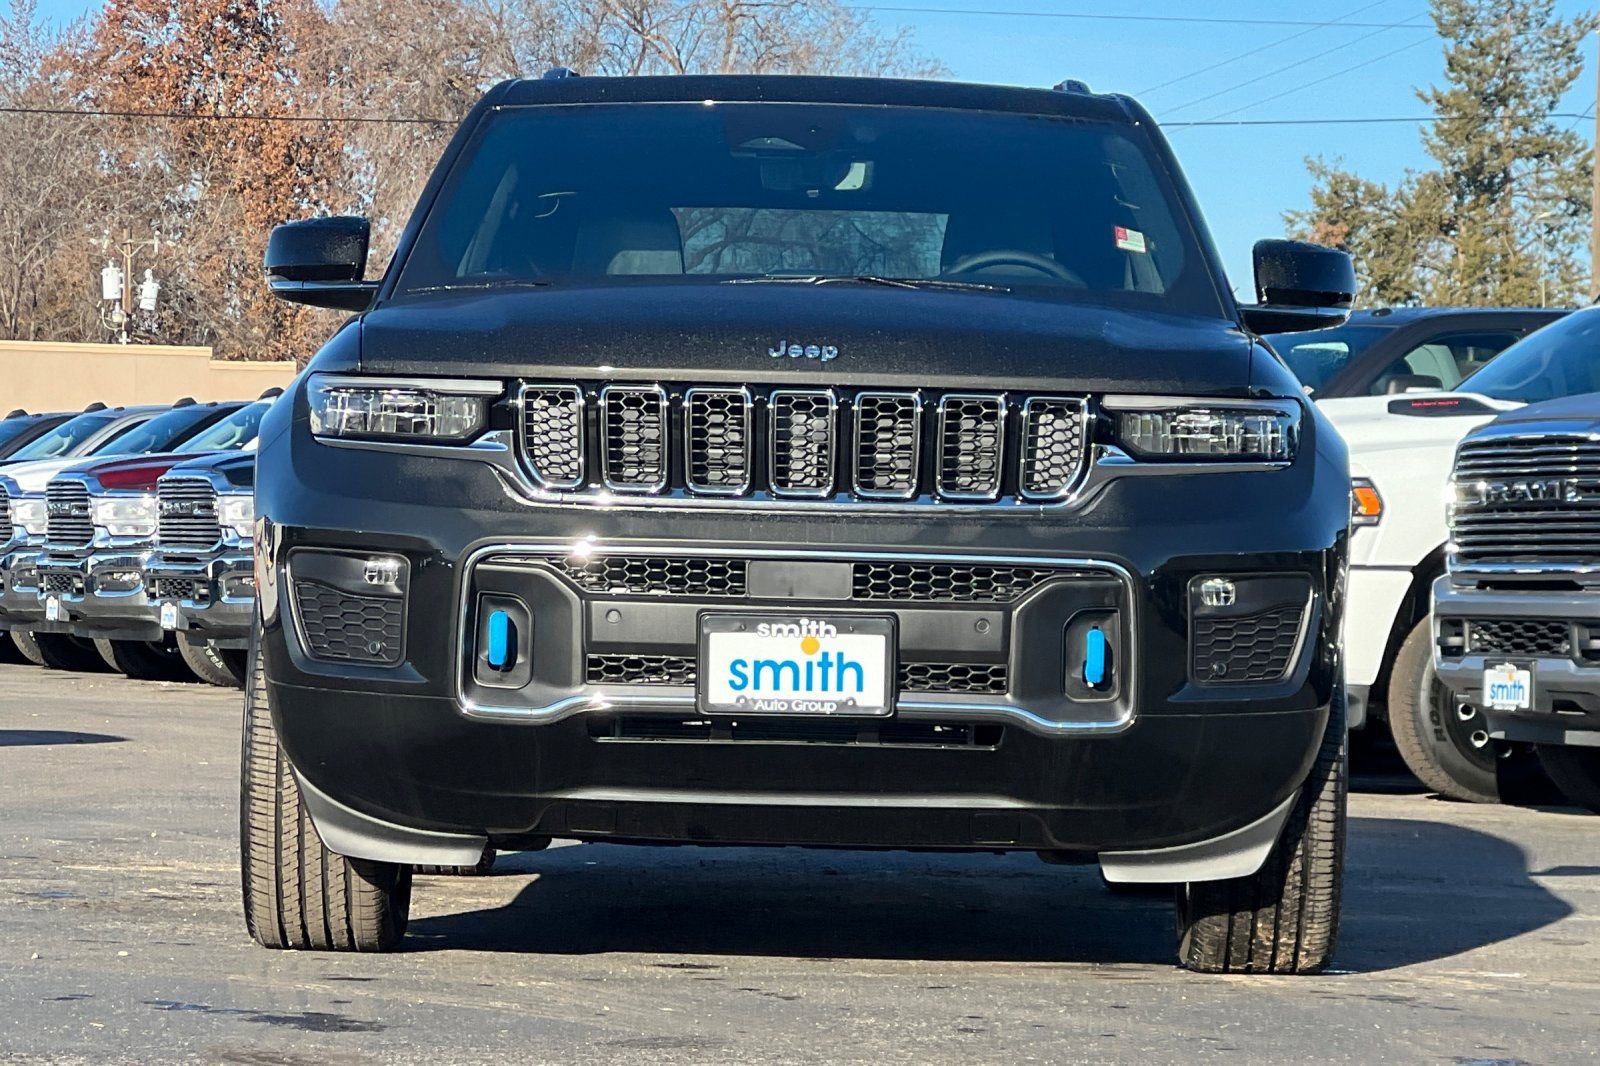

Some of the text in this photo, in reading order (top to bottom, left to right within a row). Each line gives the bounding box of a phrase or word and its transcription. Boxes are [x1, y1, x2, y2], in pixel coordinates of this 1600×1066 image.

[768, 340, 838, 362] Jeep
[757, 618, 838, 638] smith
[728, 651, 864, 693] smith
[1490, 680, 1525, 702] smith
[753, 699, 838, 714] Auto Group
